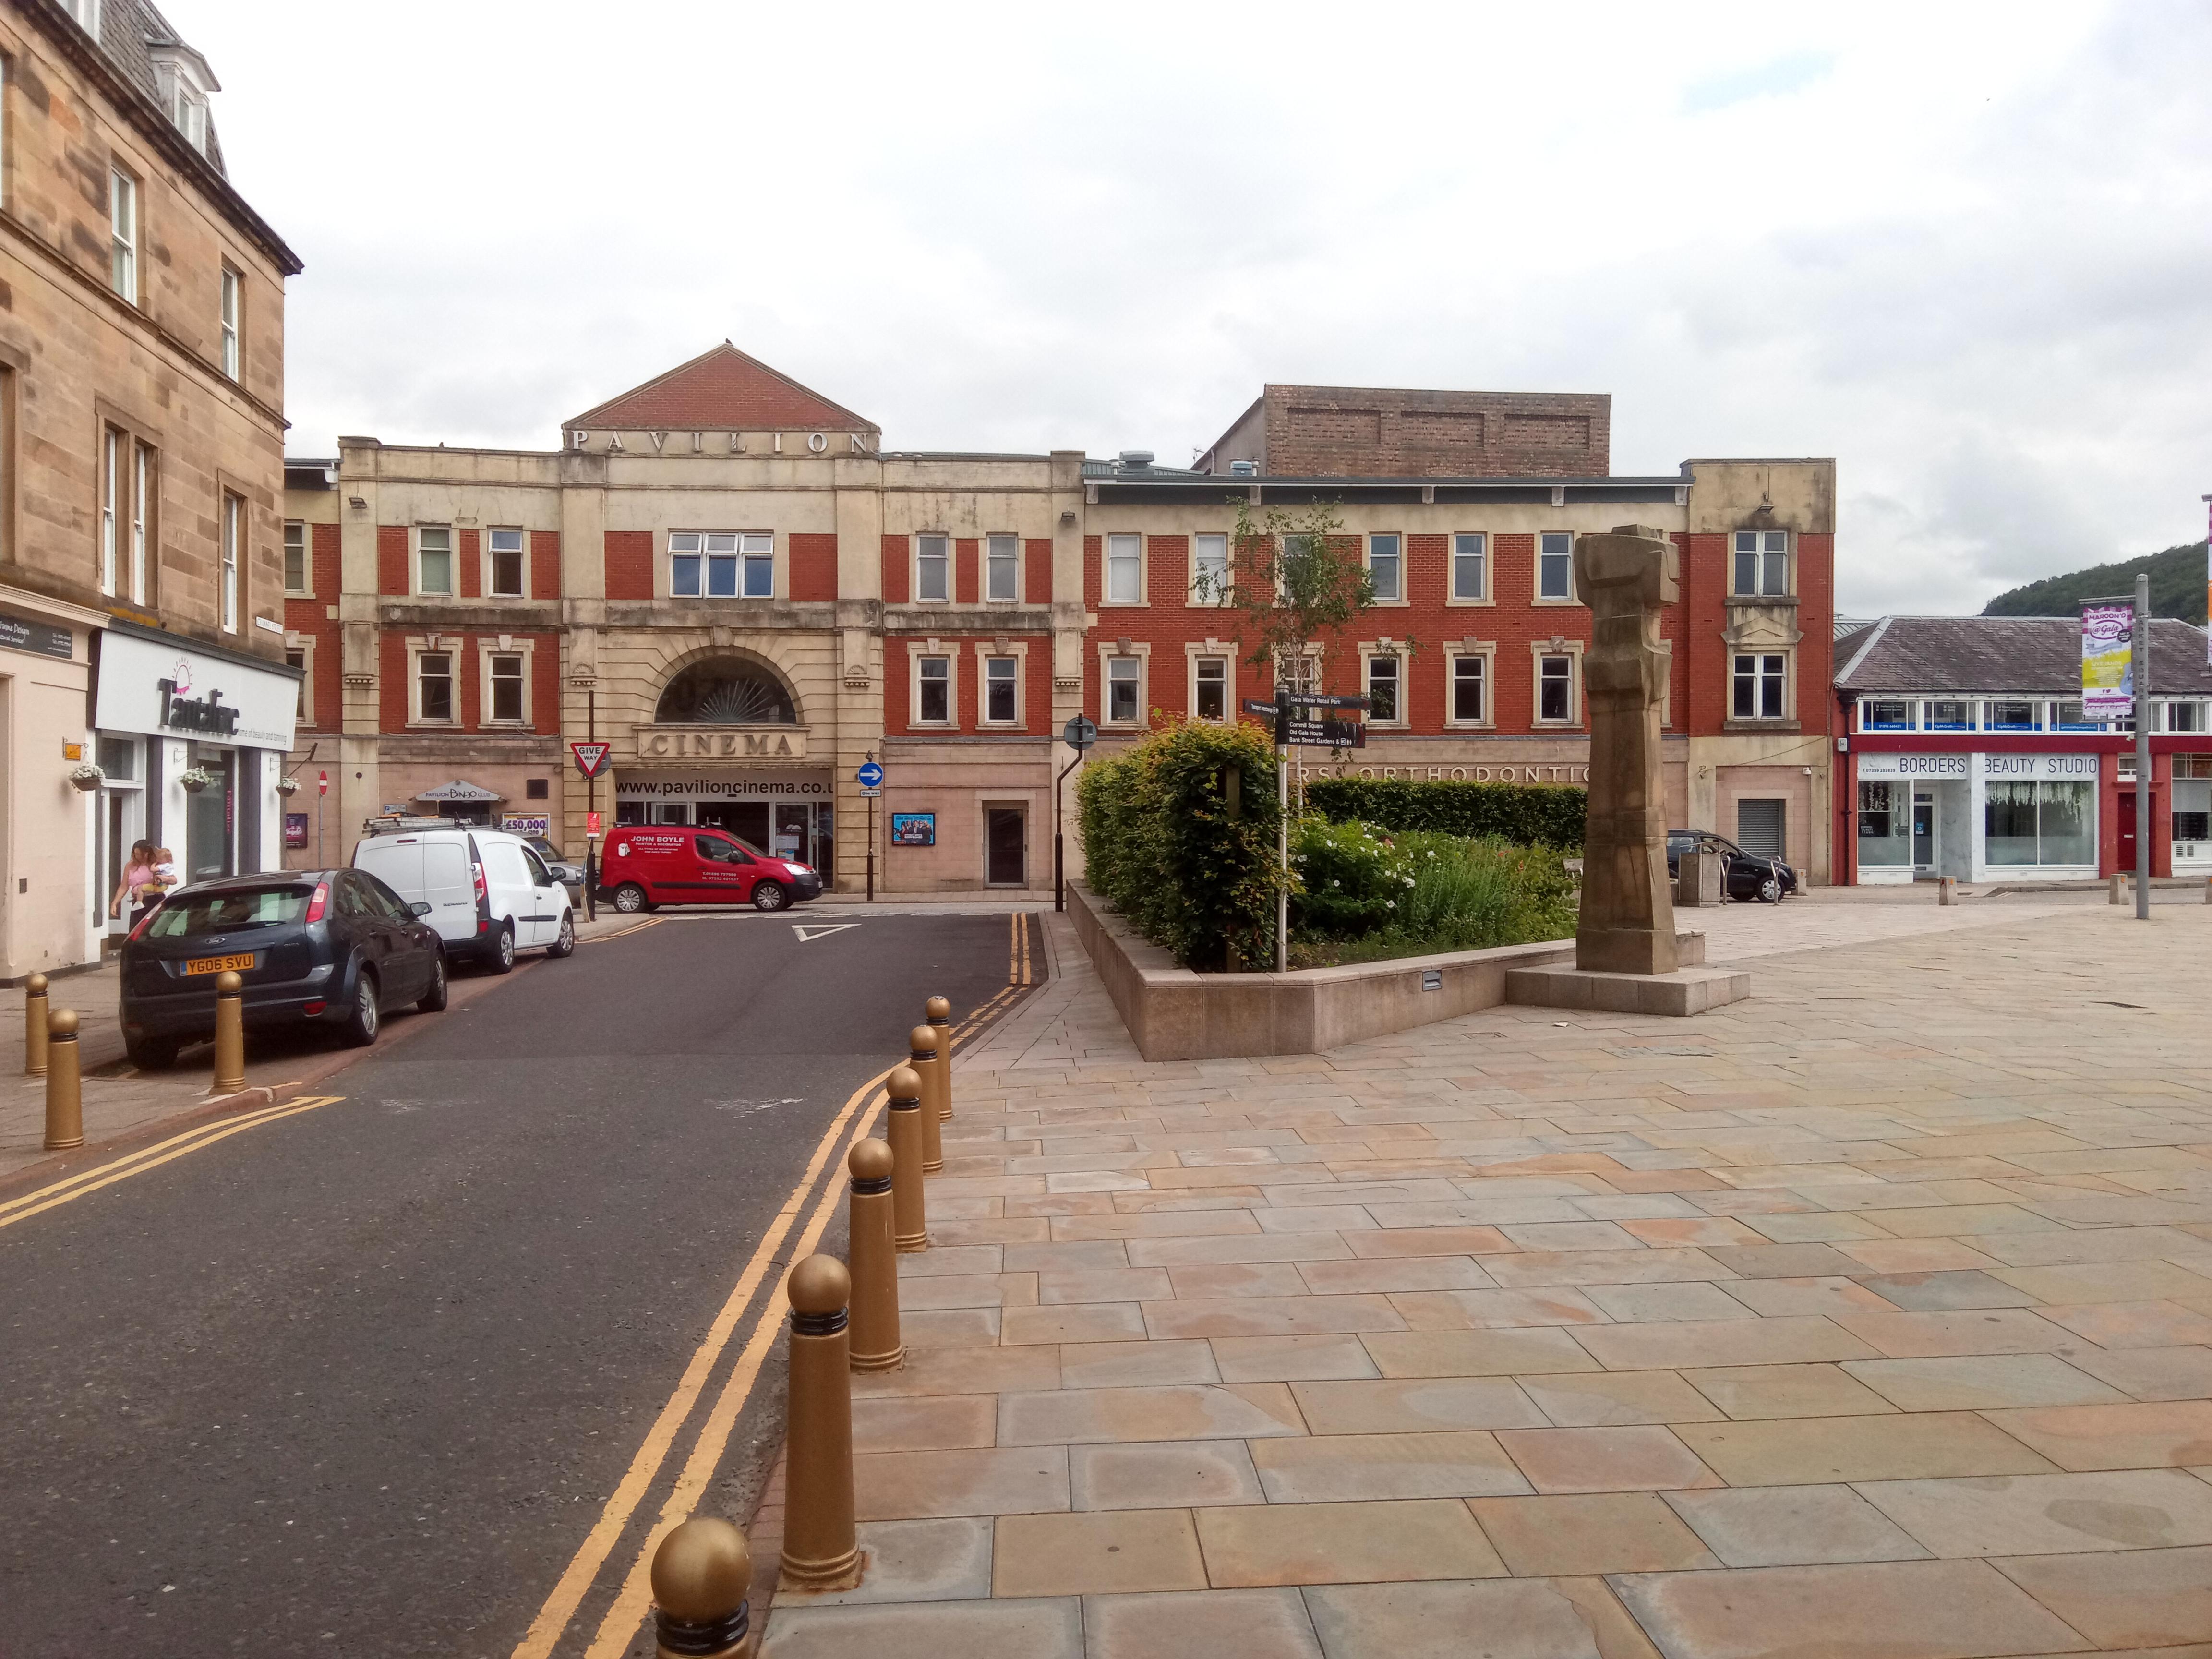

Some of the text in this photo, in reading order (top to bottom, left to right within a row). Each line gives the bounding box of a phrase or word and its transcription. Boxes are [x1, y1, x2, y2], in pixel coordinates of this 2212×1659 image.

[572, 430, 867, 452] PAVILION
[650, 734, 793, 755] CINEMA
[1900, 758, 2096, 773] BORDERS BEAUTY STUDIO
[506, 820, 545, 831] £50,000
[189, 956, 251, 973] YG06 SVU
